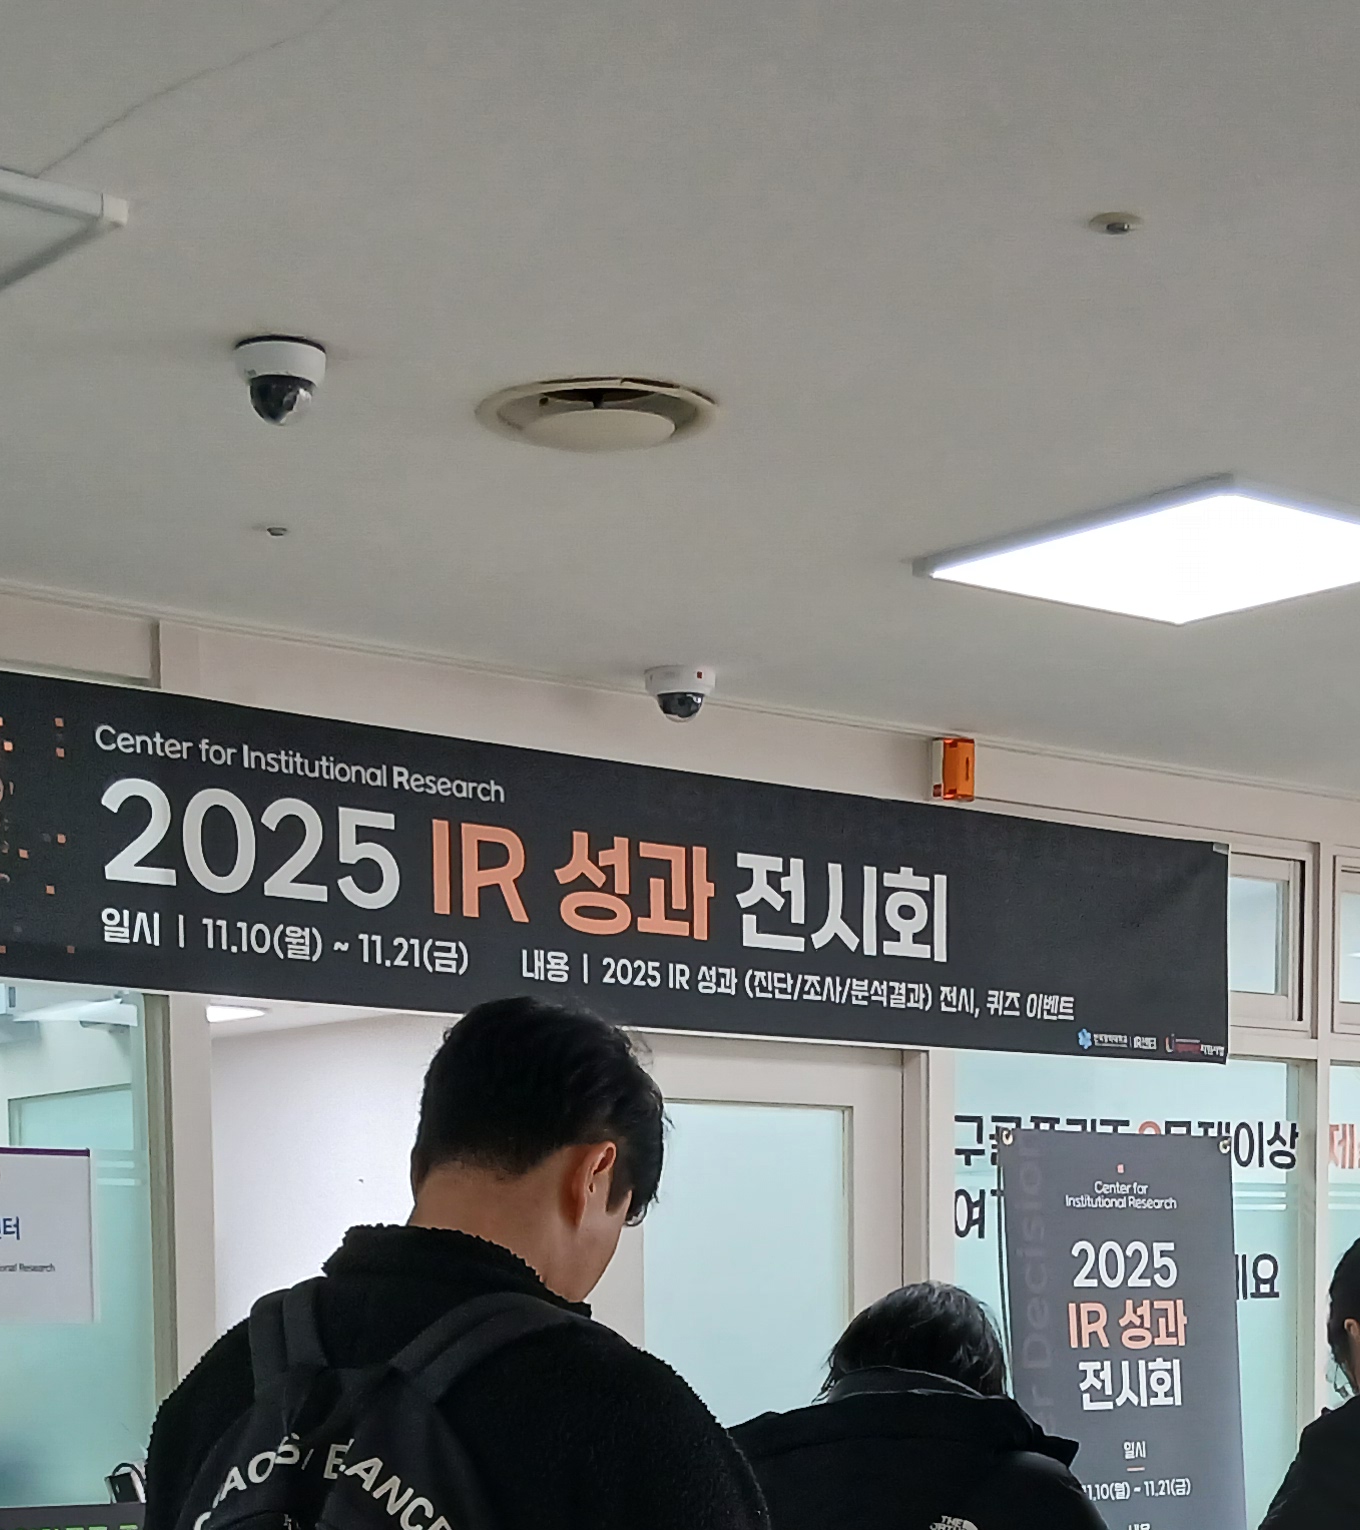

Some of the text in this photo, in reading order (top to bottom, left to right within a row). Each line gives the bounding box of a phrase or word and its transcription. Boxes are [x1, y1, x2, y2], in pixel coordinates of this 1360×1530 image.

[95, 724, 505, 803] Center for Institutional Research
[100, 778, 949, 963] 2025 IR 성과 전시회
[101, 907, 160, 946] 일시
[202, 917, 323, 963] 11.10(월)
[358, 932, 469, 976] 11.21(금)
[521, 949, 570, 984] 내용
[602, 957, 661, 988] 2025
[668, 963, 691, 991] IR
[698, 965, 738, 996] 성과
[745, 967, 932, 1014] (진단/조사/분석결과)
[940, 985, 980, 1019] 전시,
[986, 990, 1021, 1017] 퀴즈
[1026, 992, 1075, 1023] 이벤트
[1064, 1194, 1177, 1210] Institutional Research
[1094, 1180, 1149, 1195] Center for
[19, 1263, 55, 1273] Research
[1071, 1241, 1178, 1288] 2025
[1067, 1299, 1187, 1350] IR 성과
[1079, 1358, 1183, 1412] 전시회
[1123, 1441, 1147, 1459] 일시
[1143, 1478, 1191, 1497] 11.21(금)
